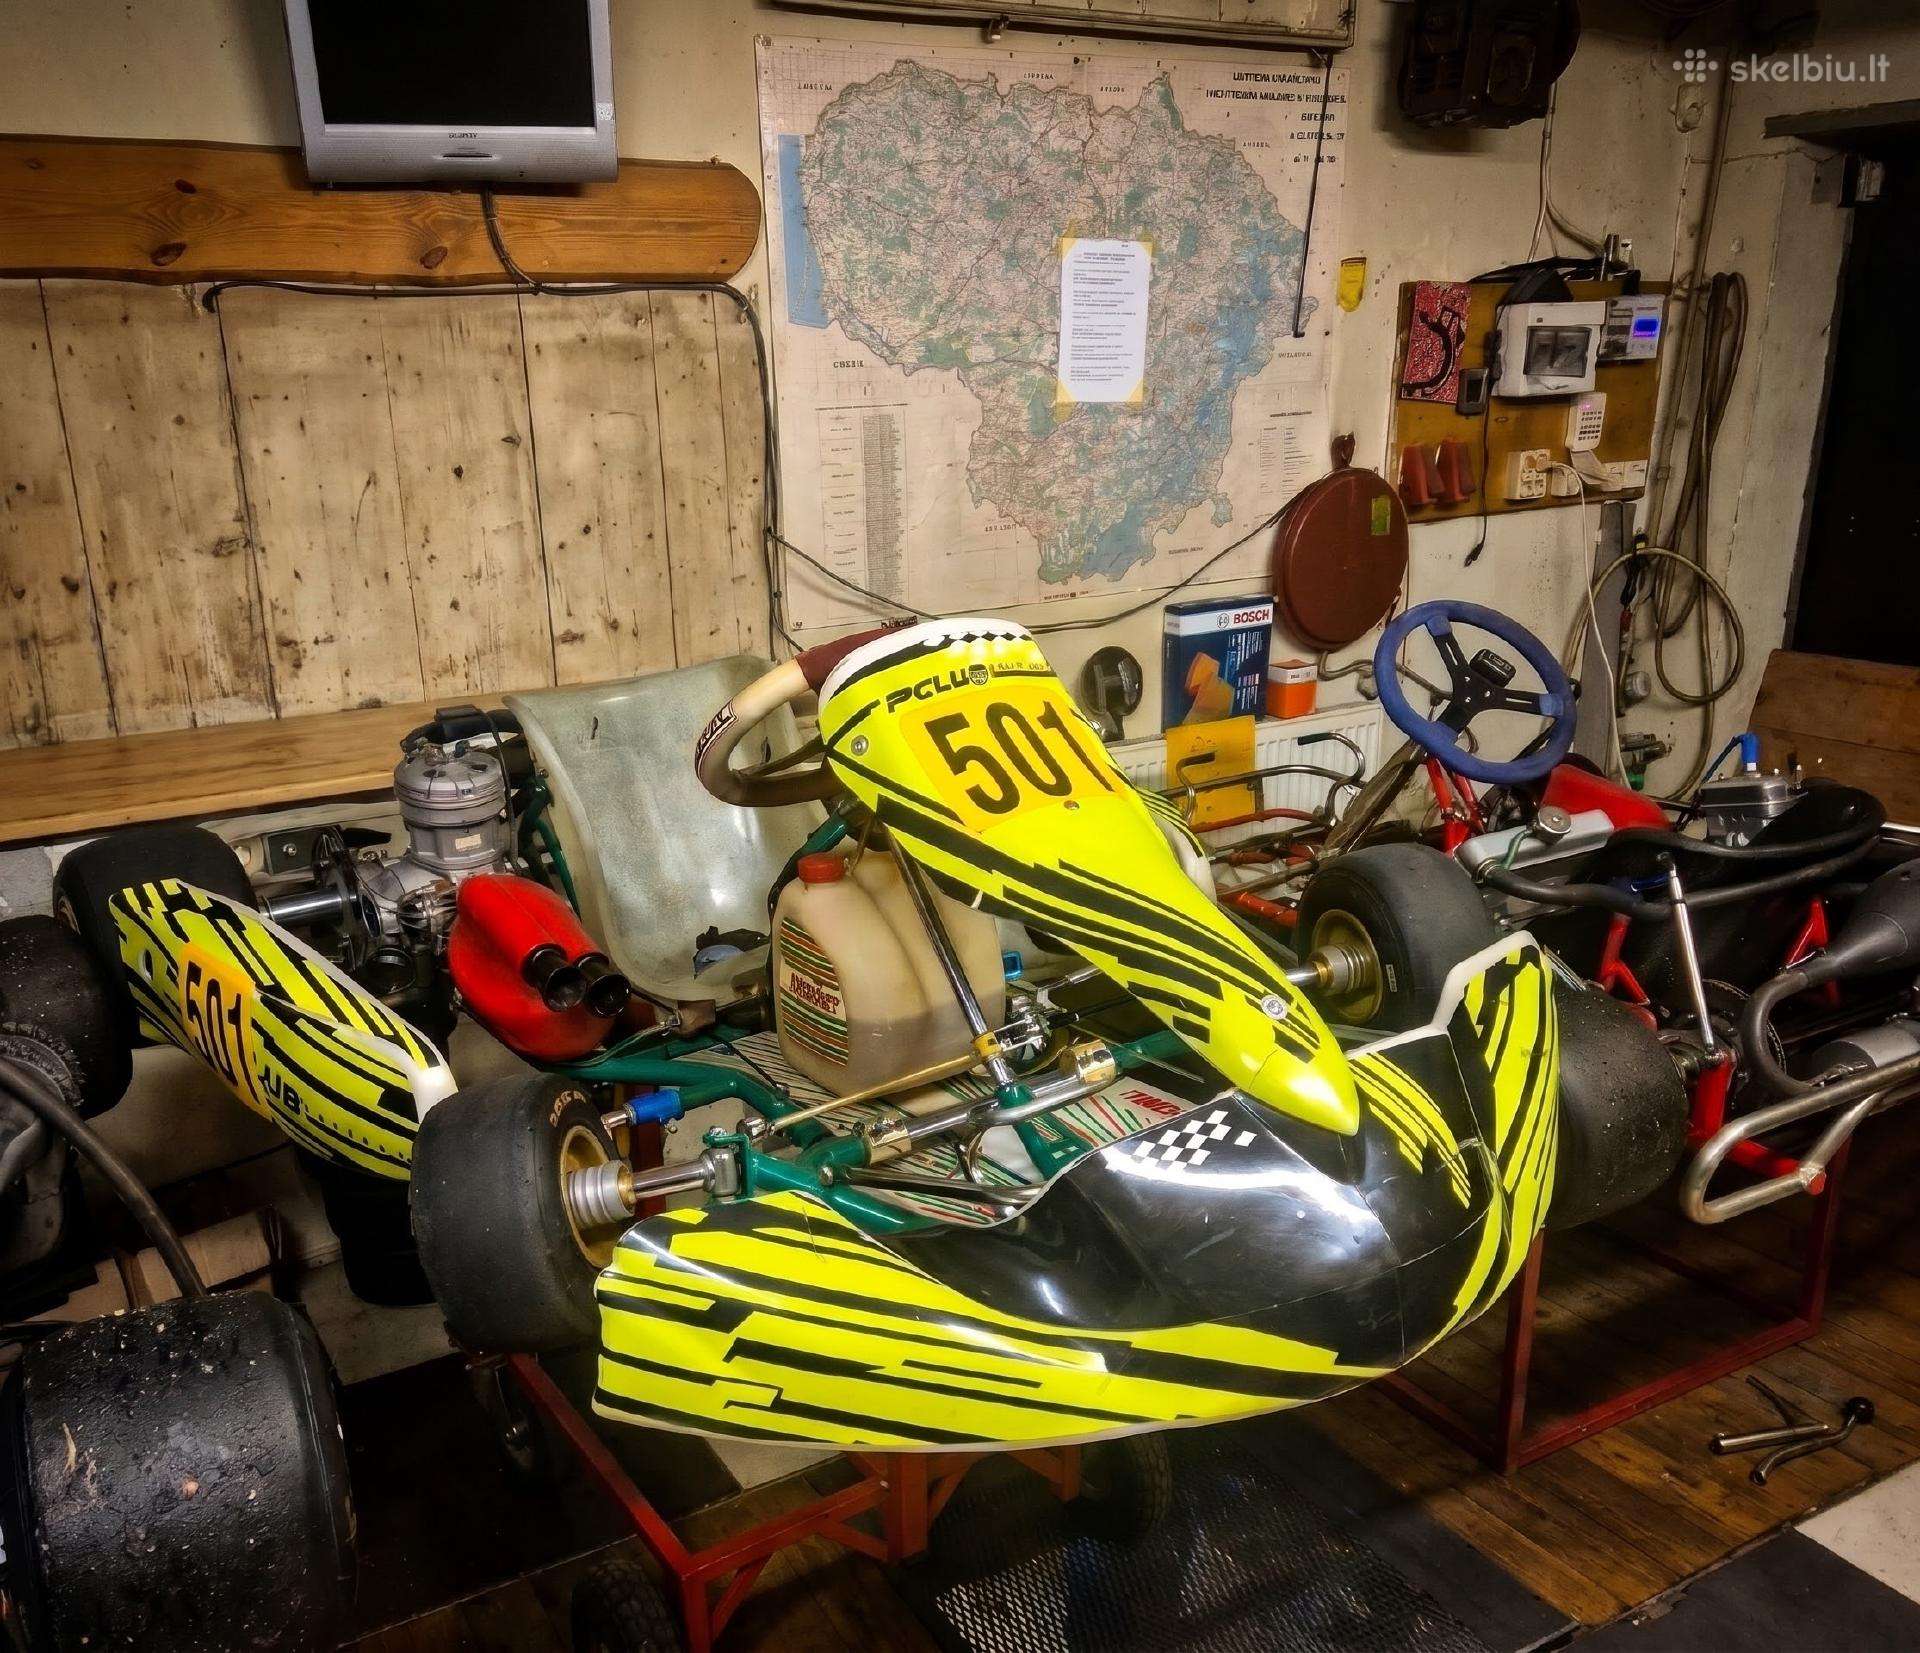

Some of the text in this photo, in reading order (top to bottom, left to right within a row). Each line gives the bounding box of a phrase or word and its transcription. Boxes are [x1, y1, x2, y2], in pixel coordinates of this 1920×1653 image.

[1233, 609, 1270, 625] BOSCH
[923, 700, 1115, 815] 501
[185, 959, 261, 1105] 501
